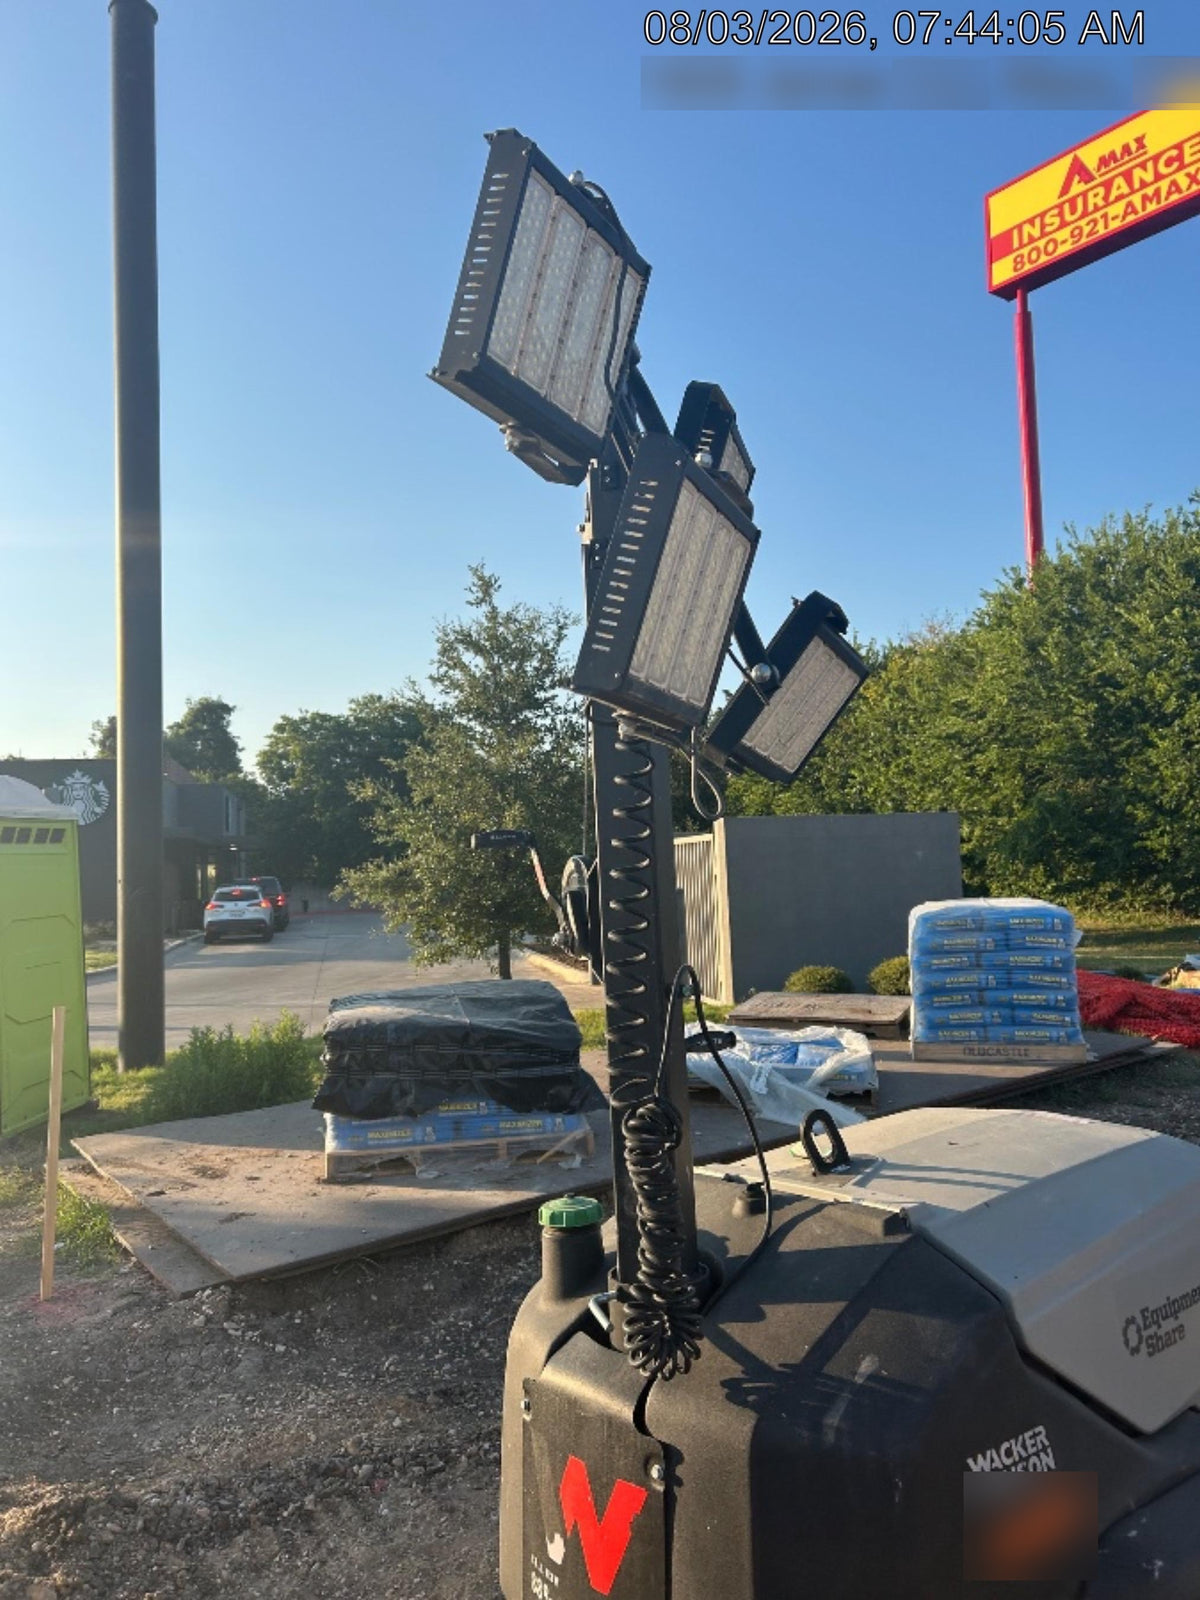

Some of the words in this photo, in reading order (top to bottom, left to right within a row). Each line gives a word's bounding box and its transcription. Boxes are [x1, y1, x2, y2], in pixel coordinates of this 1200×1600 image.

[1011, 139, 1200, 250] INSURANCE
[1012, 167, 1200, 273] 800-921-AMAX
[1145, 1323, 1185, 1358] Share
[966, 1425, 1050, 1472] WACKER
